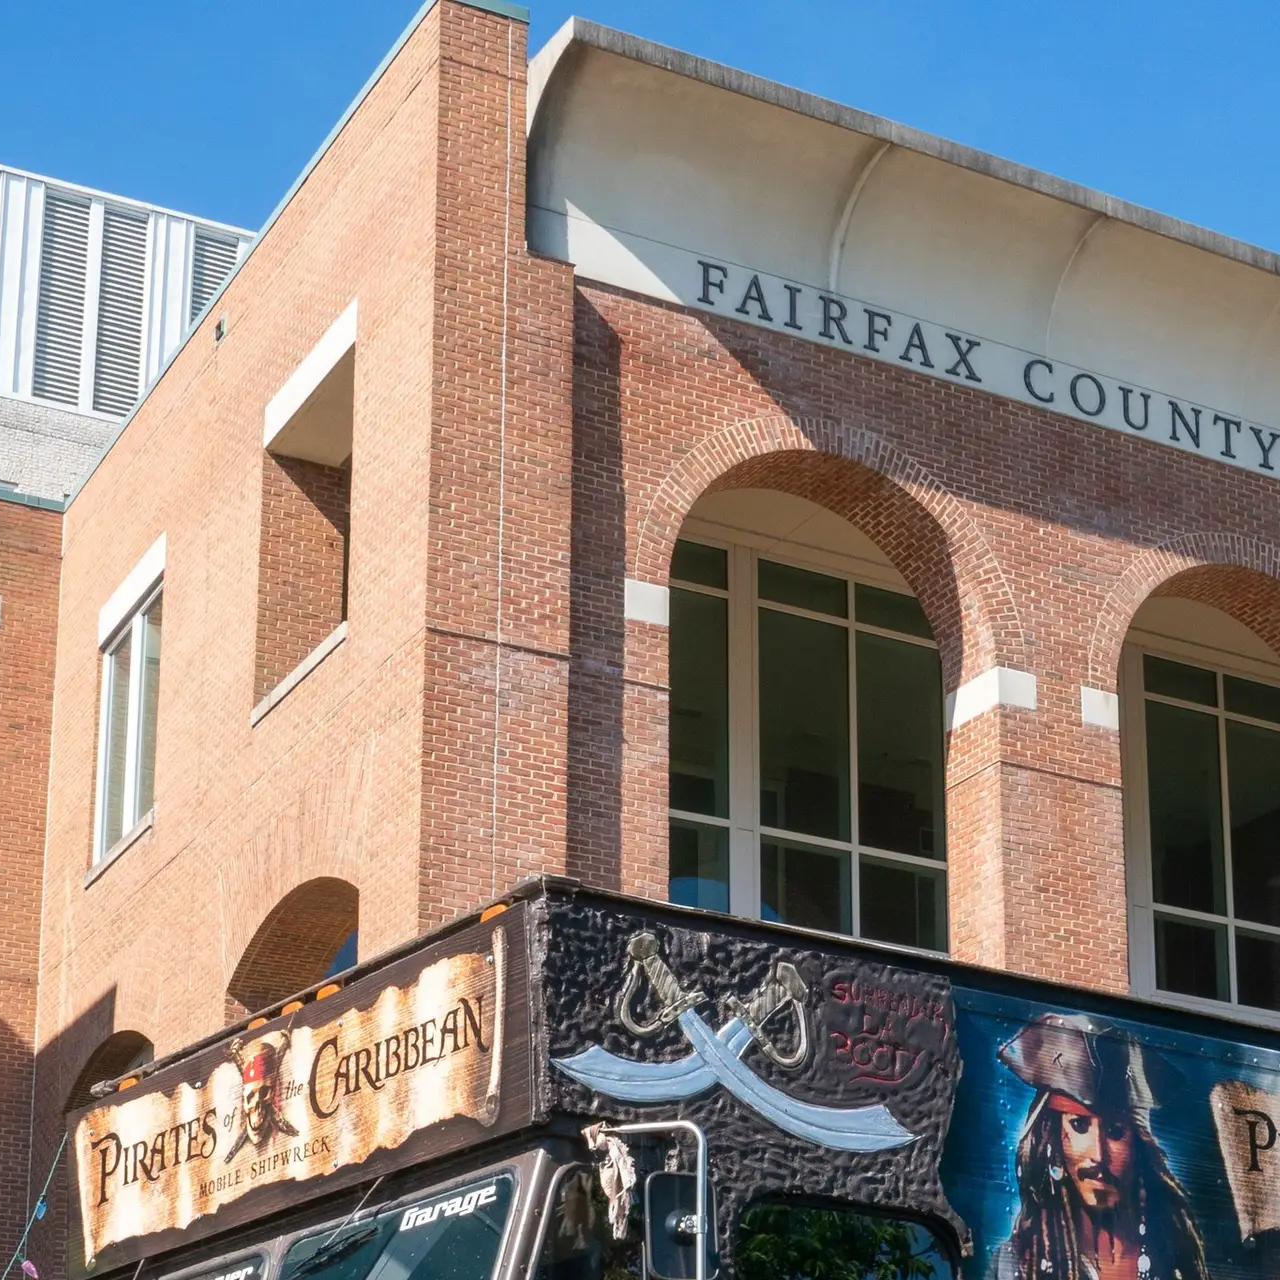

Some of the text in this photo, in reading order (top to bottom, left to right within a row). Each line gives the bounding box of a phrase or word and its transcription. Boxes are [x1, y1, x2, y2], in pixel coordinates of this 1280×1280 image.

[696, 259, 983, 383] FAIRFAX
[90, 995, 490, 1208] PIRATES of the CARIBBEAN
[199, 1134, 332, 1199] MOBILE SHIPWRECK
[399, 1184, 497, 1232] Garage
